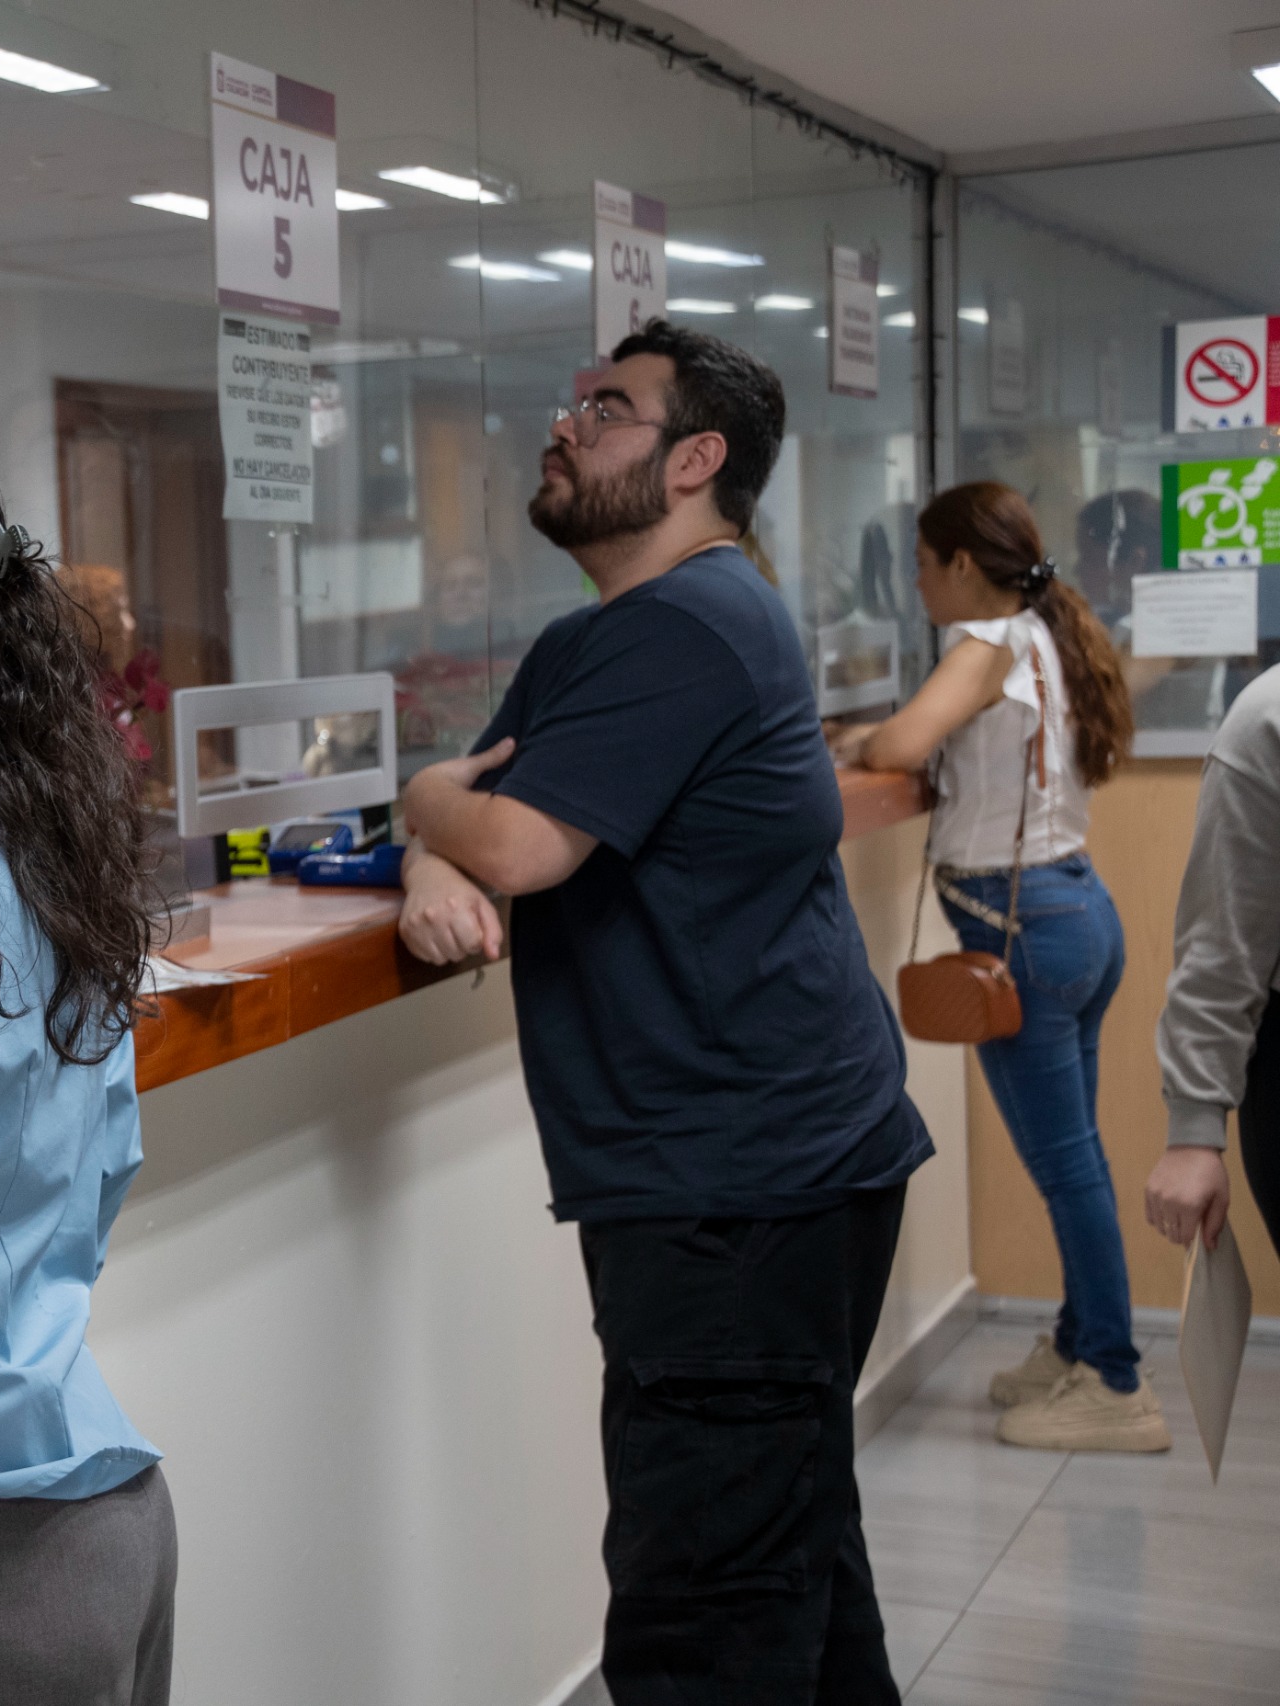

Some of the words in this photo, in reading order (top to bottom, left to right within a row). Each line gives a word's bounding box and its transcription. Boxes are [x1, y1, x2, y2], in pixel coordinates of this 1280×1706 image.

[239, 136, 314, 208] CAJA
[273, 215, 293, 280] 5
[611, 240, 655, 291] CAJA
